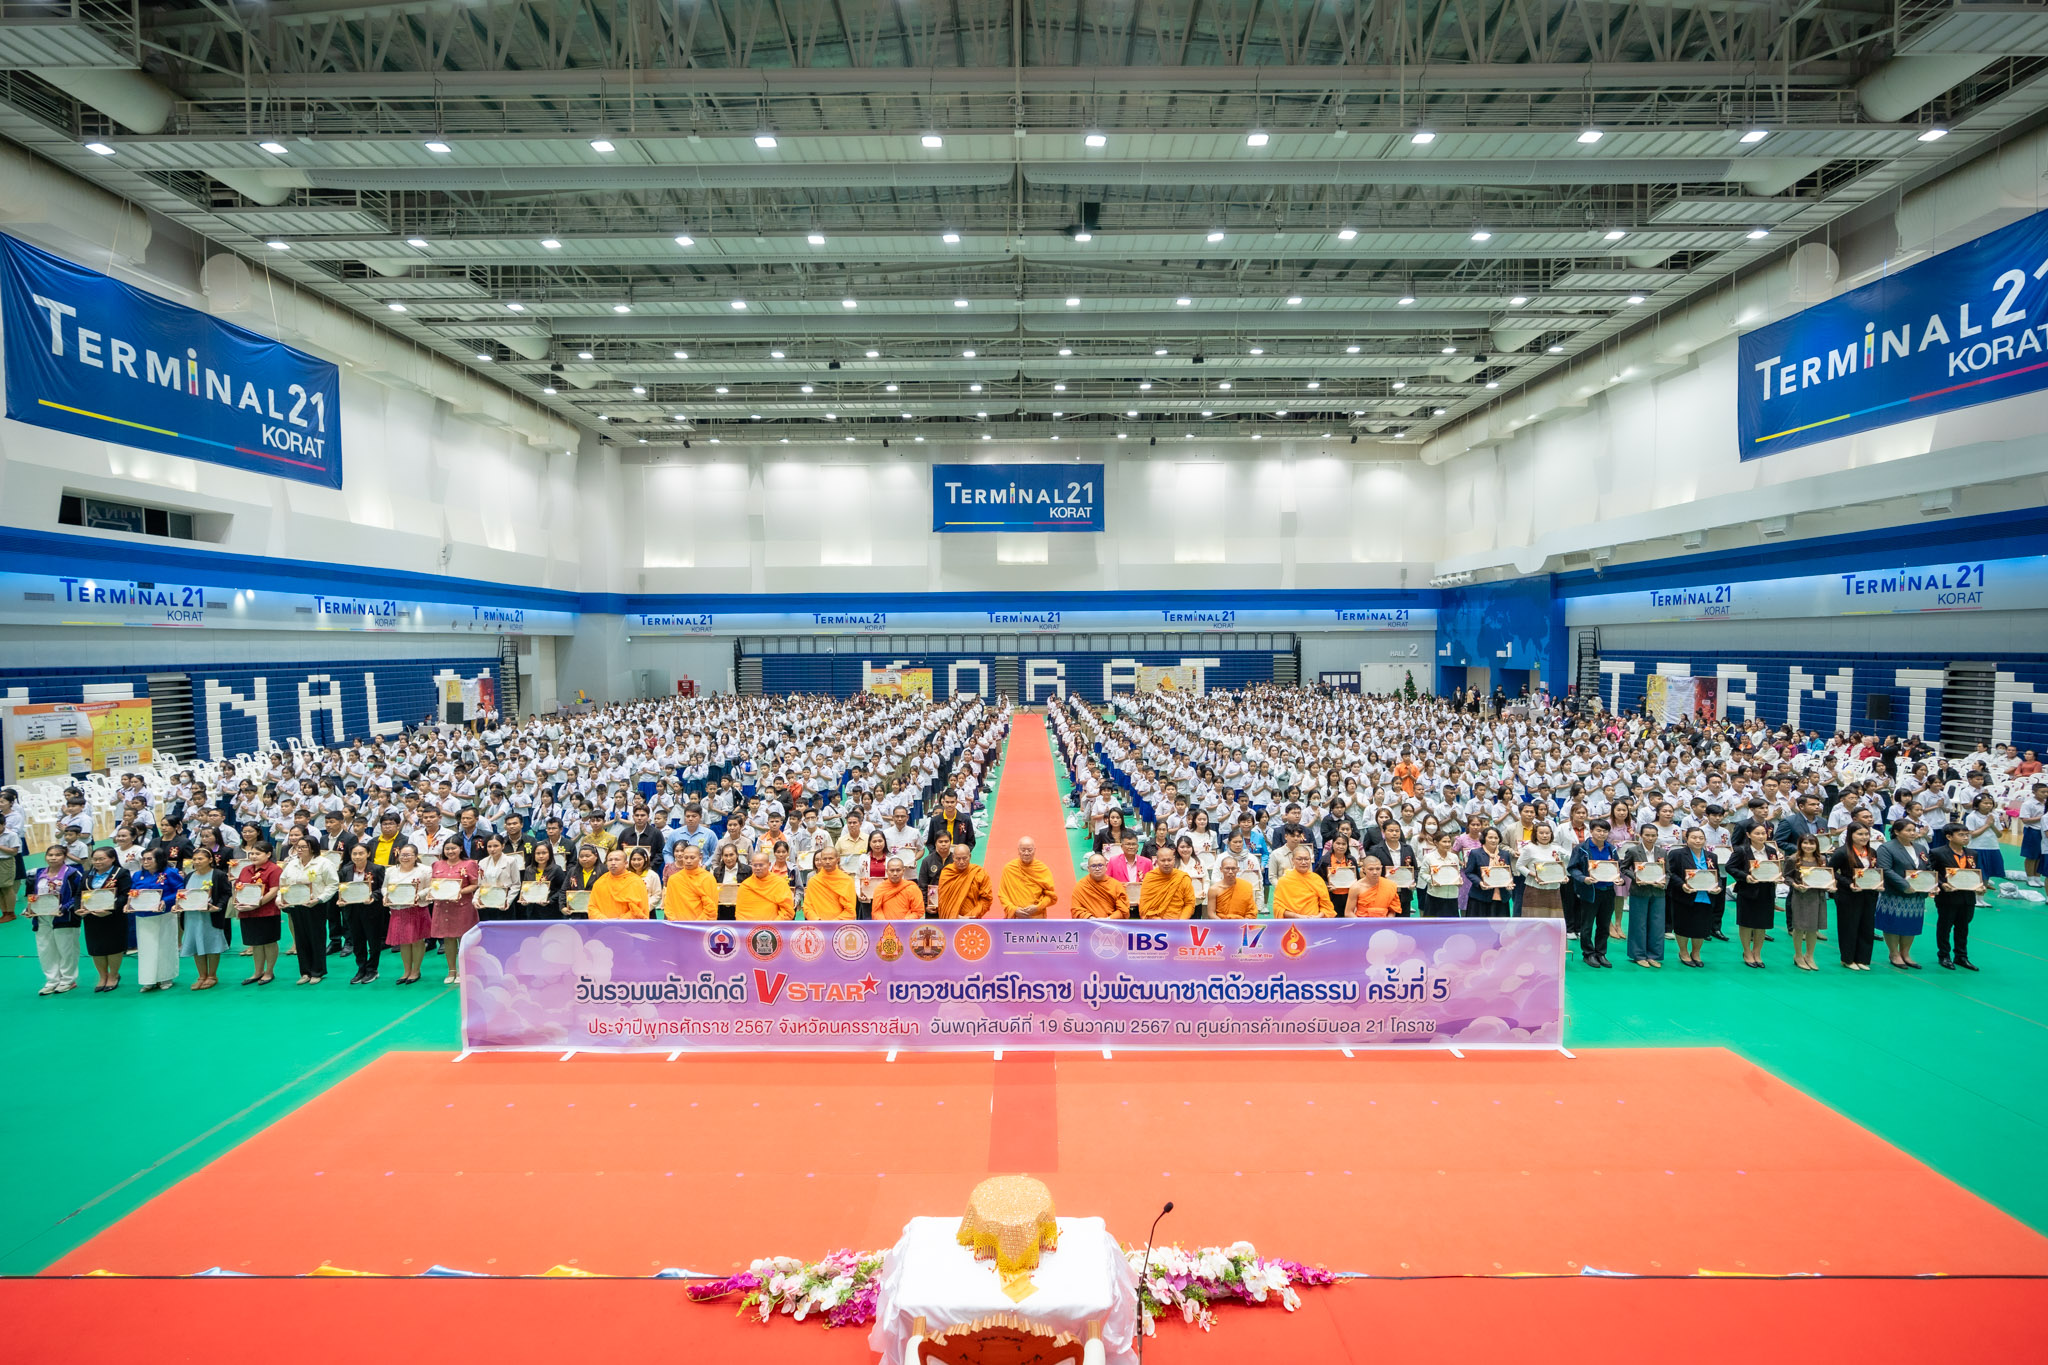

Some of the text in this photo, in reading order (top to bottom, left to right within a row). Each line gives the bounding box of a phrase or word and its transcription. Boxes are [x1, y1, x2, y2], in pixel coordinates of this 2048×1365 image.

[262, 424, 325, 459] KORAT
[1050, 507, 1093, 519] KORAT
[1938, 591, 1983, 605] KORAT
[167, 611, 203, 621] KORAT
[1705, 606, 1730, 615] KORAT
[374, 618, 396, 627] KORAT
[1409, 643, 1418, 657] 2
[1128, 933, 1168, 951] IBS
[1190, 925, 1210, 947] V
[1178, 947, 1216, 956] STAR
[577, 974, 745, 1001] วันรวมพลังเด็กดี
[889, 975, 1072, 1001] เยาวชนดีศรีโคราช
[1084, 974, 1356, 1008] มุ่งพัฒนาชาติด้วยศีลธรรม
[1369, 967, 1424, 1001] ครั้งที่
[1432, 978, 1448, 1001] 5
[589, 1013, 1435, 1040] ประจำปีพุทธศักราช 2567 จังหวัดนครราชสีมา วันพฤหัสบดีที่ 19 ธันวาคม 2567 ณ ศูนย์การค้าเทอร์มินอล 21 โคราช
